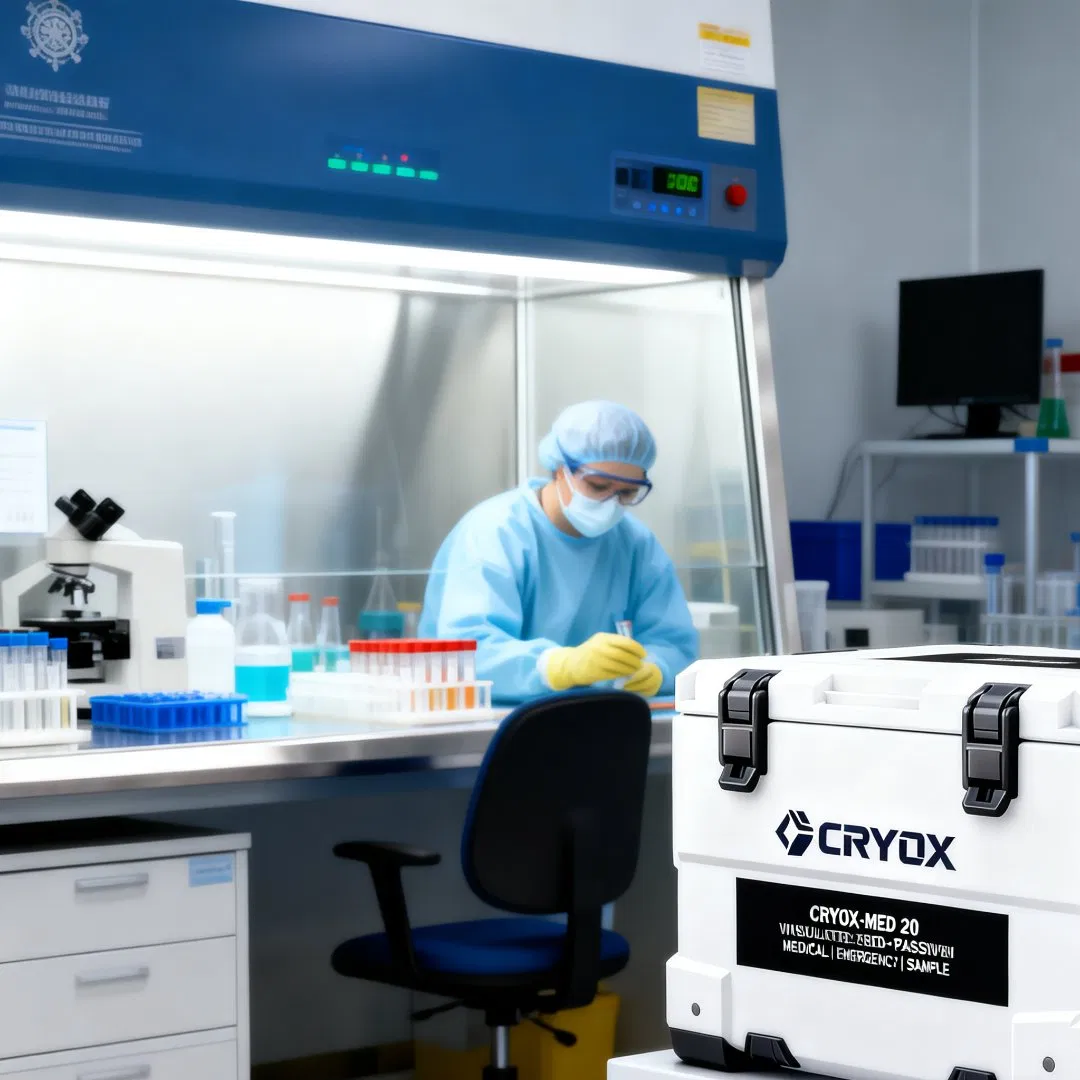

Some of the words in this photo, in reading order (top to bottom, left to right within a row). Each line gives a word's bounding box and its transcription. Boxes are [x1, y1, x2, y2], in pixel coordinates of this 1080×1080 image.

[819, 822, 957, 872] CRYOX
[809, 904, 896, 931] CRYOX-MED
[900, 917, 920, 937] 20
